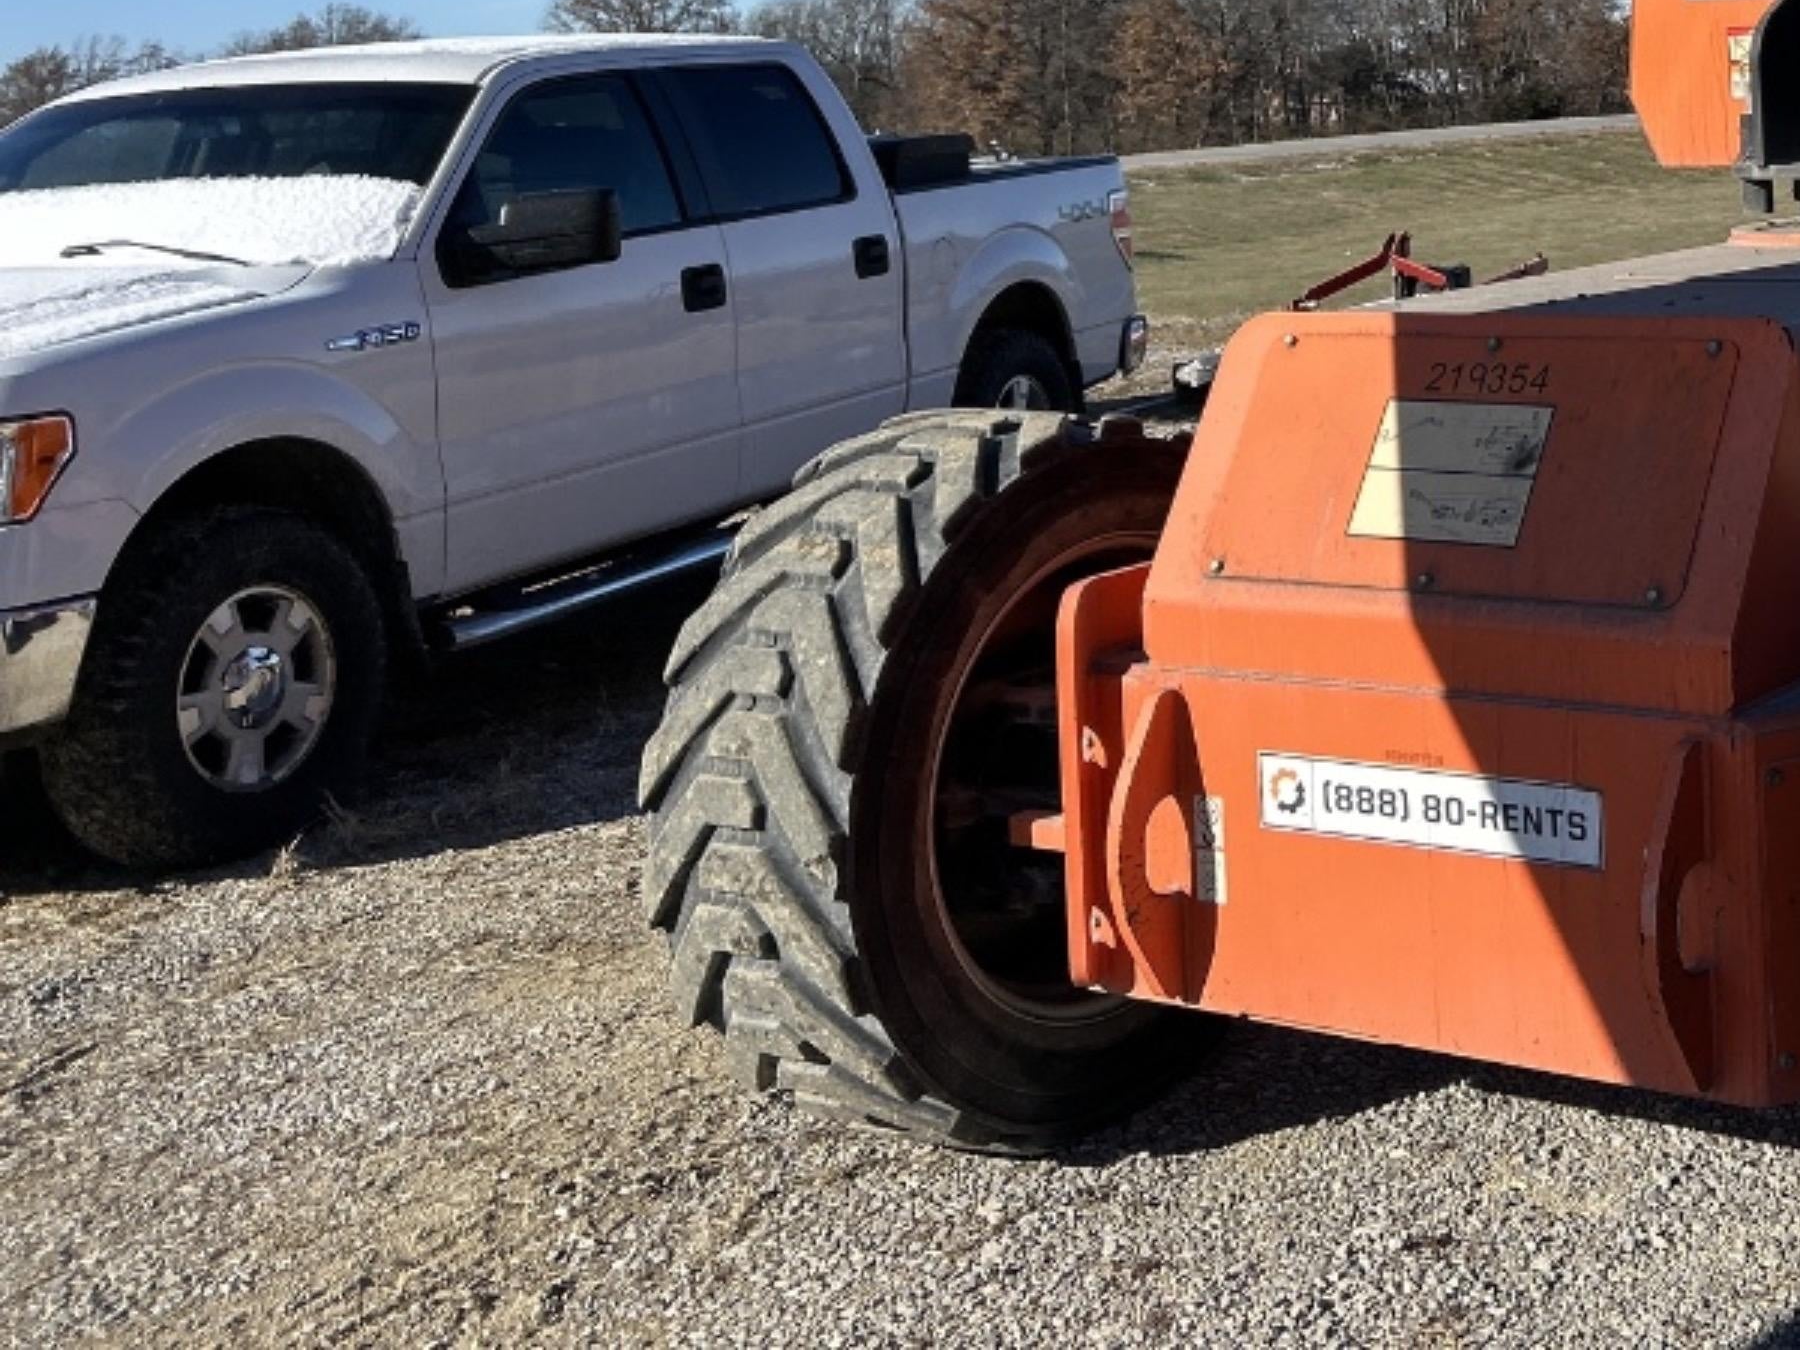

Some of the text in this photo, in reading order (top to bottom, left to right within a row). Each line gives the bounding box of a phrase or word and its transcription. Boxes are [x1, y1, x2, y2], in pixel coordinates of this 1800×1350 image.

[1424, 361, 1551, 394] 219354
[1322, 779, 1588, 841] (888) 80-RENTS
